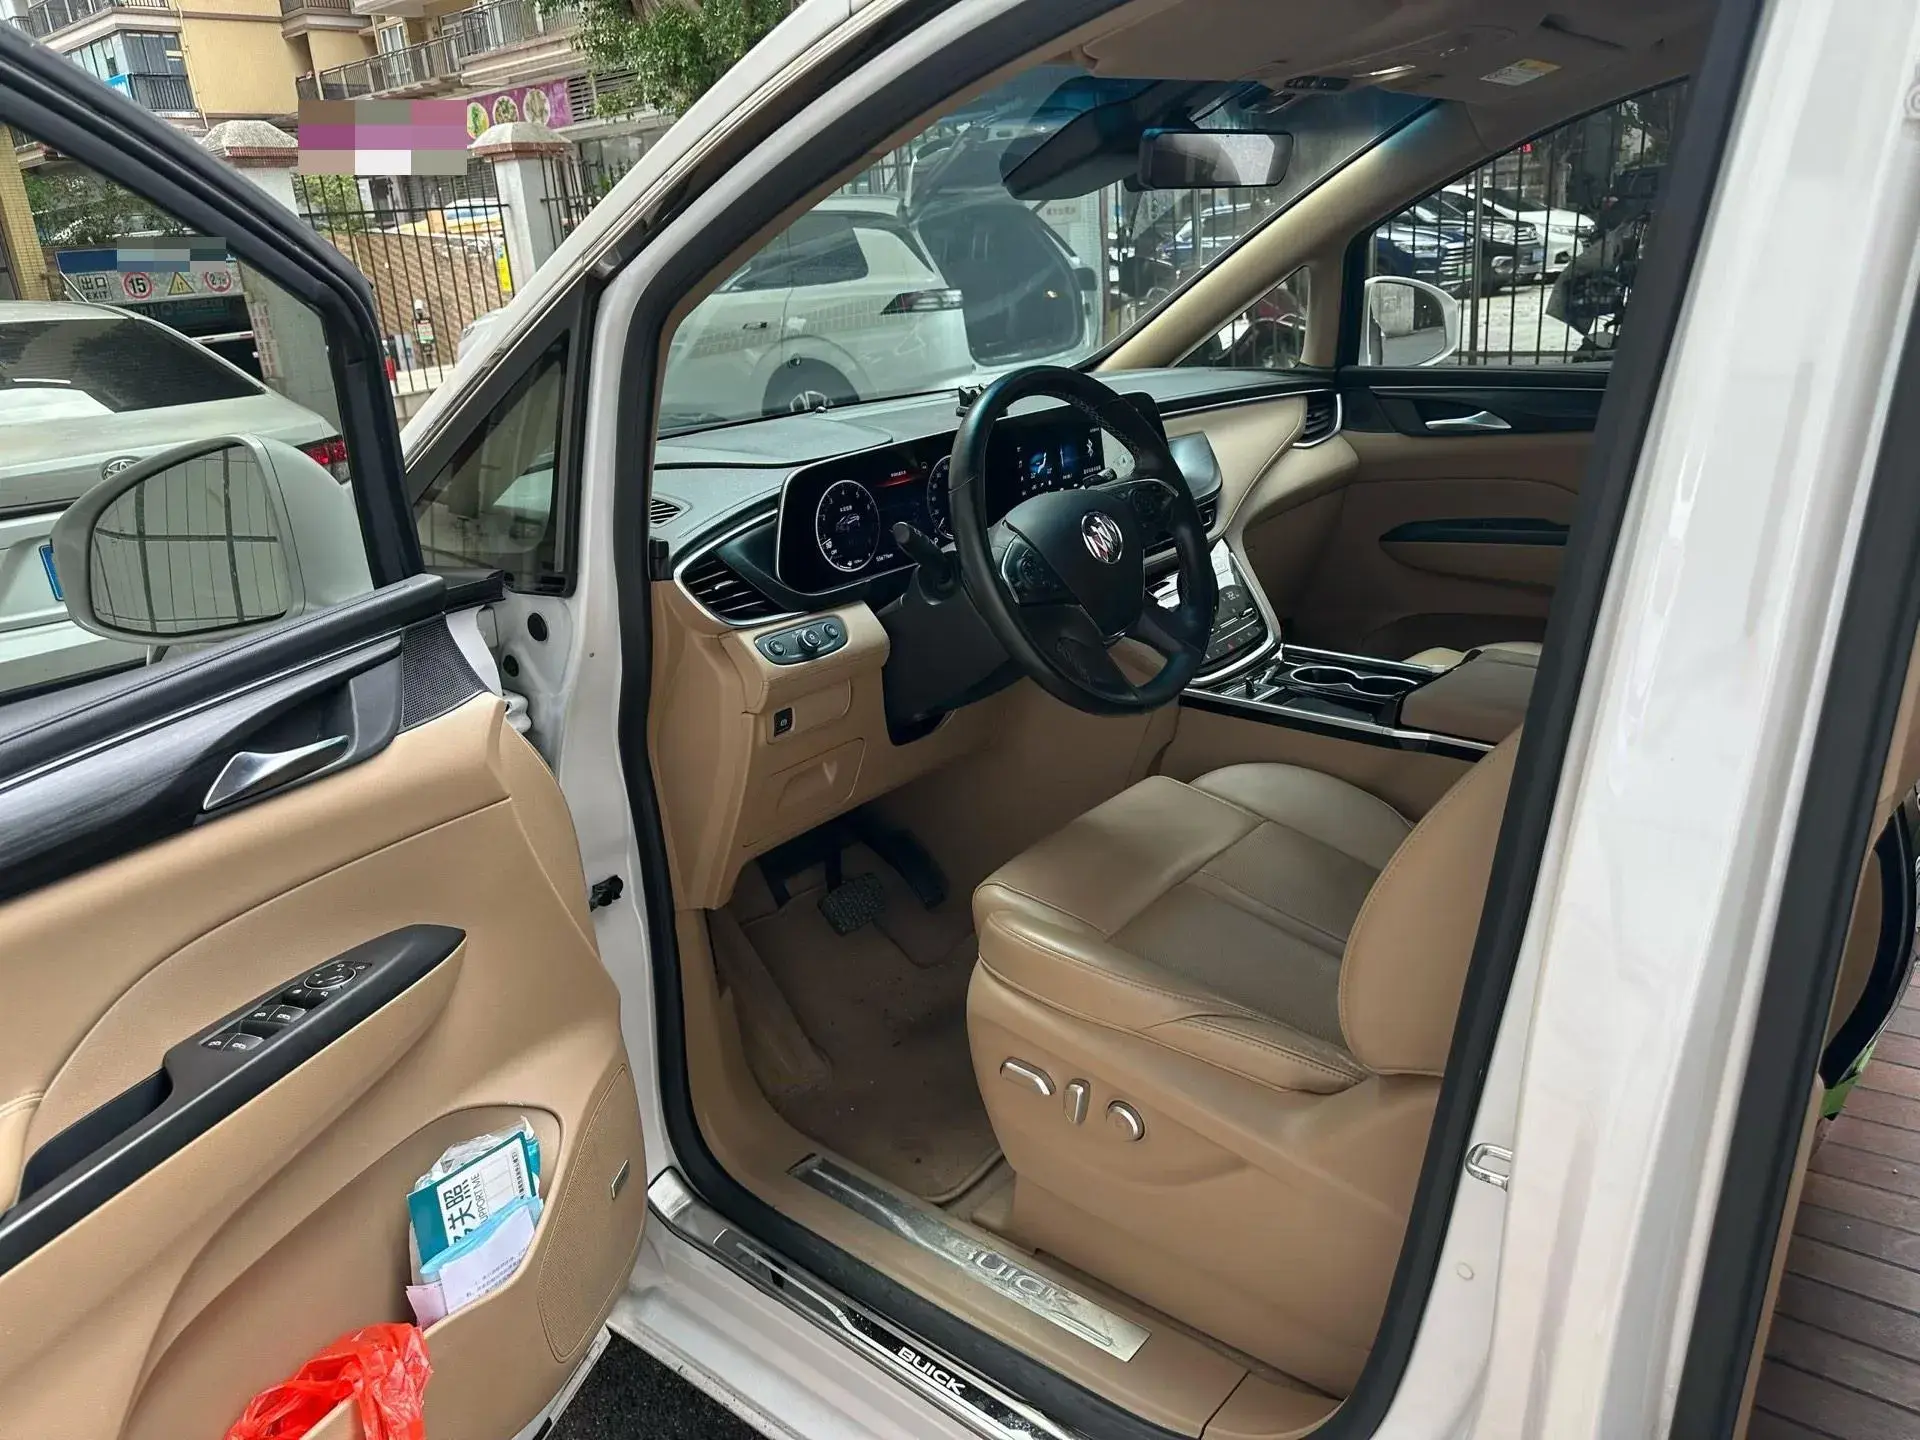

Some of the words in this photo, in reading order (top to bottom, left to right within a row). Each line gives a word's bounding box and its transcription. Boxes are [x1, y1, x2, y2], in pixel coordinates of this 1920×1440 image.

[80, 276, 107, 290] 出口
[128, 277, 147, 294] 15
[86, 291, 107, 300] EXIT
[470, 1171, 481, 1190] ME
[442, 1178, 477, 1244] 关照
[952, 1238, 1080, 1308] BUICK
[897, 1345, 966, 1396] BUICK
